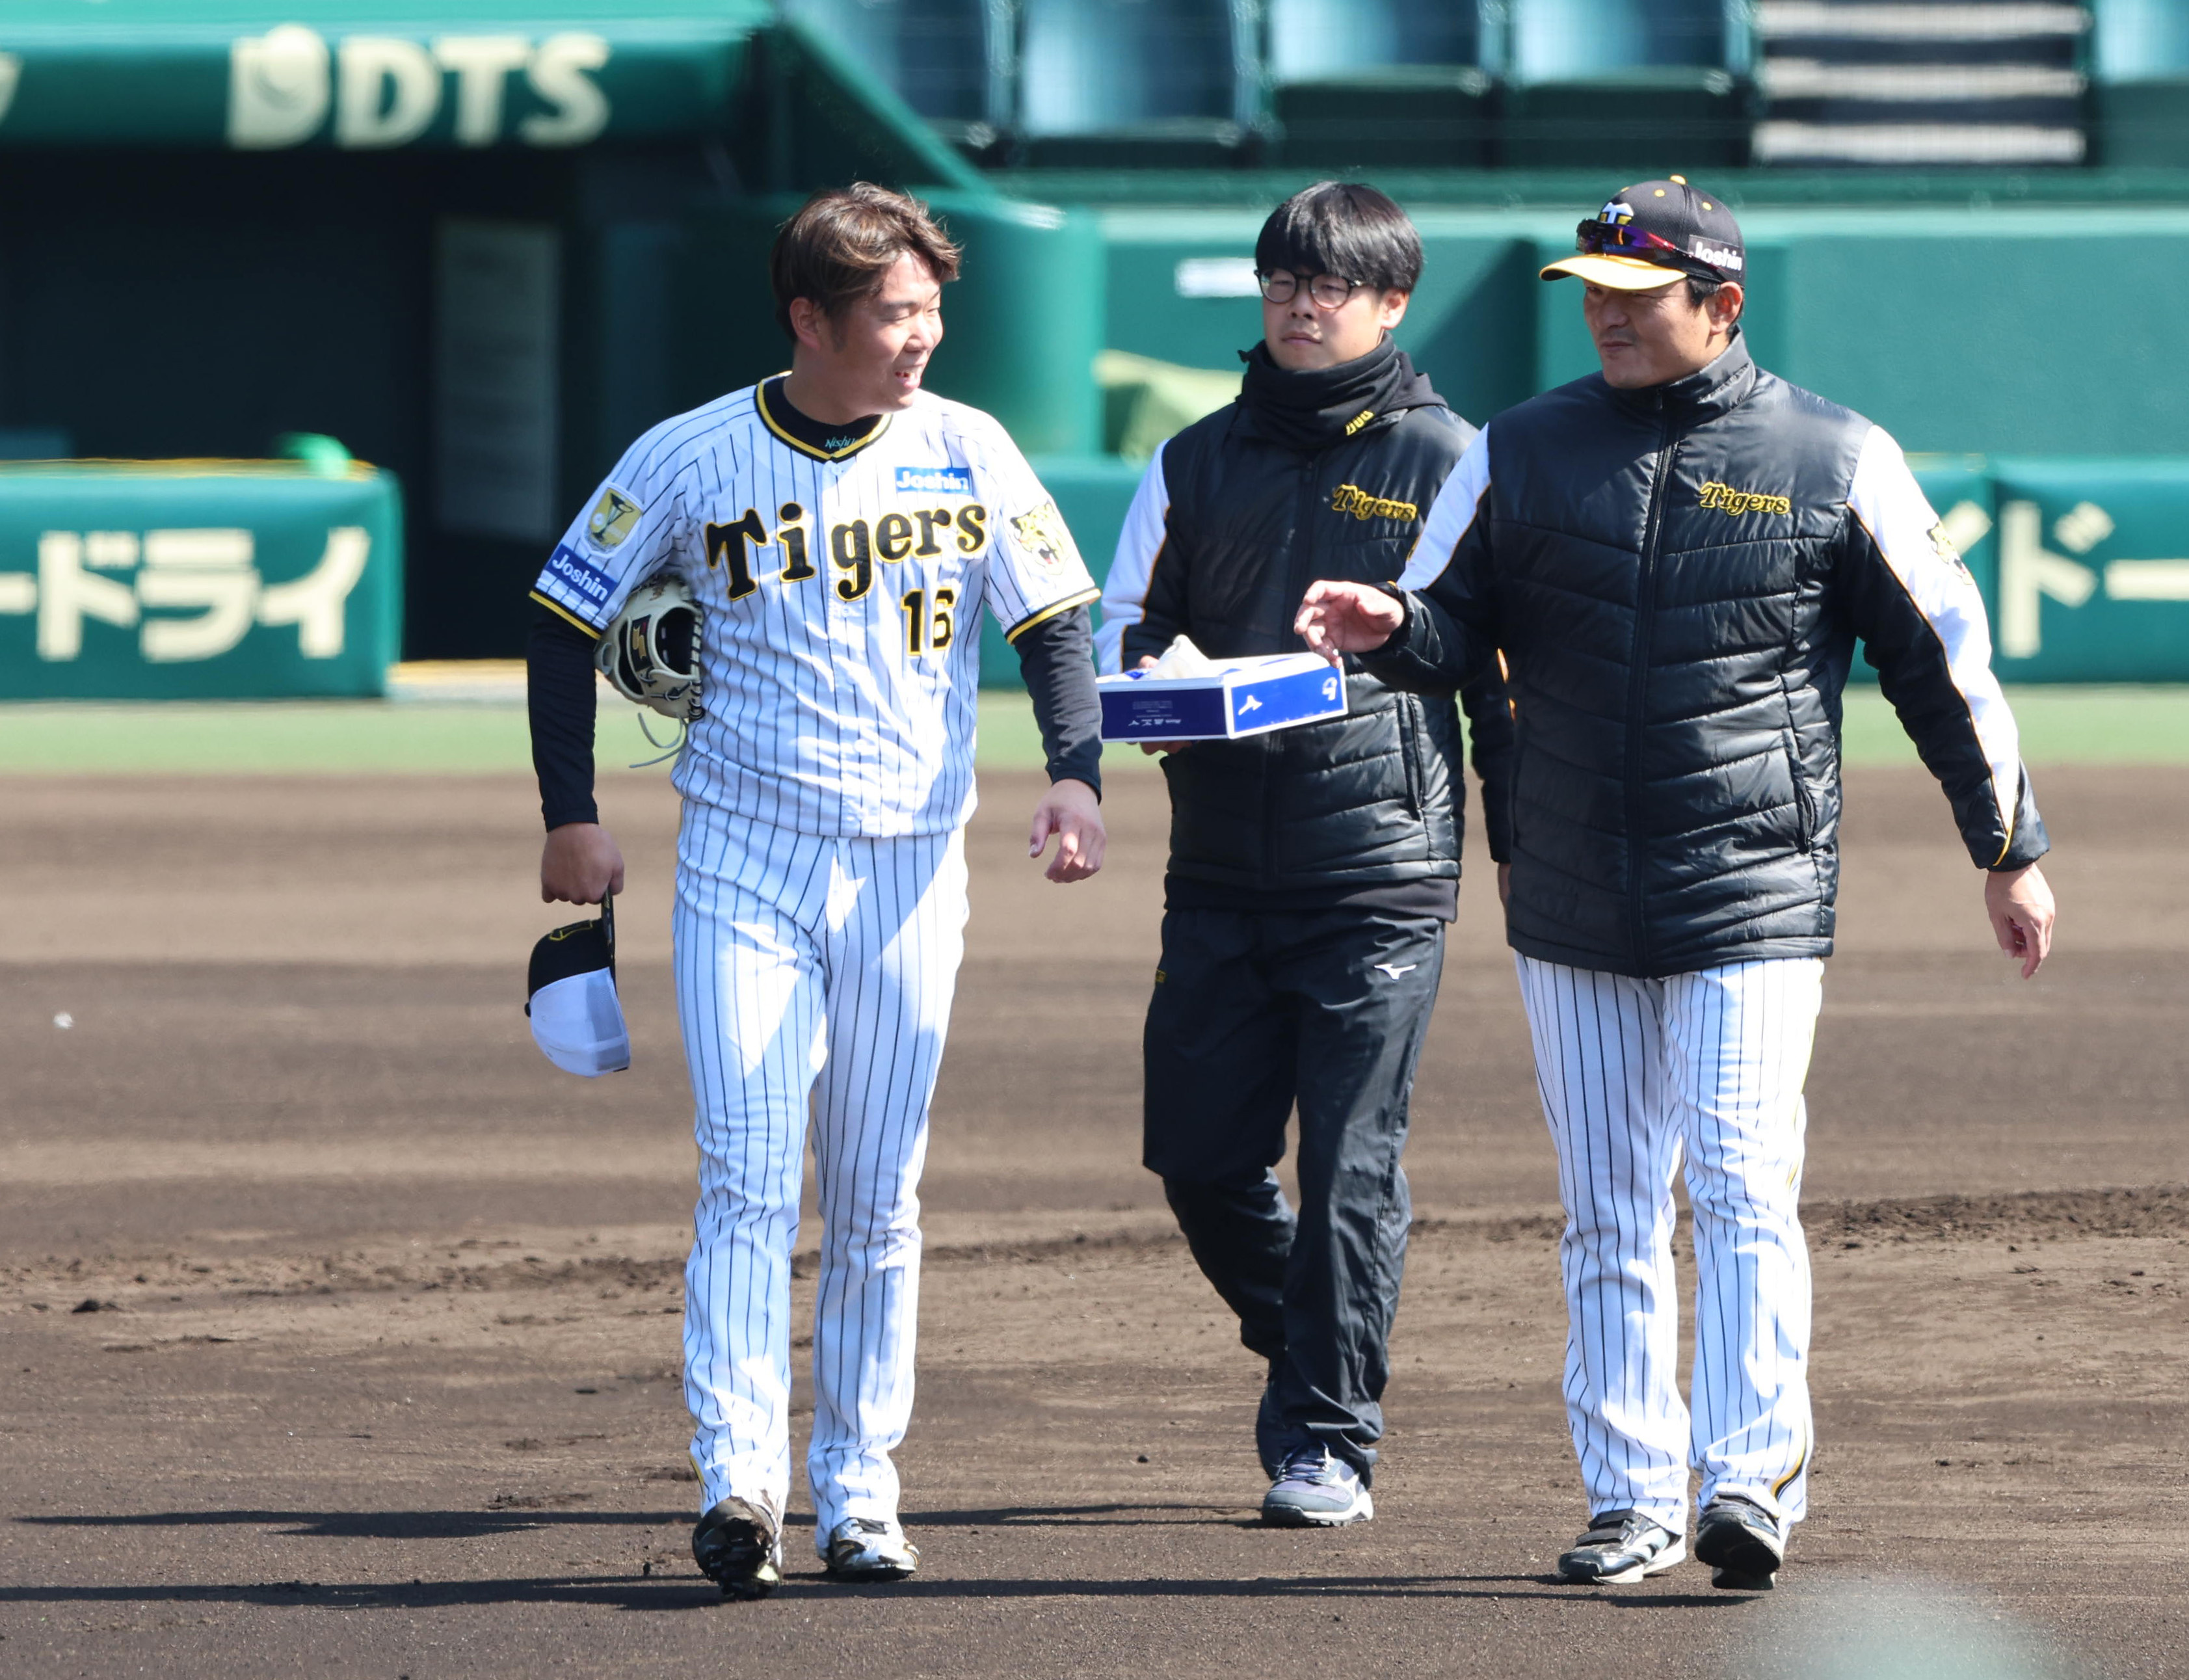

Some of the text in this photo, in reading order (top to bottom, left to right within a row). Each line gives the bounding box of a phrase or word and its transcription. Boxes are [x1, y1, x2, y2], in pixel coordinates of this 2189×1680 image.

[334, 33, 612, 150] DTS
[1693, 241, 1742, 271] Joshin
[896, 470, 969, 490] Joshin
[1699, 481, 1791, 516] Tigers
[1332, 484, 1418, 522] Tigers
[705, 501, 987, 602] Tigers
[551, 553, 609, 602] Joshin
[900, 586, 955, 656] 16
